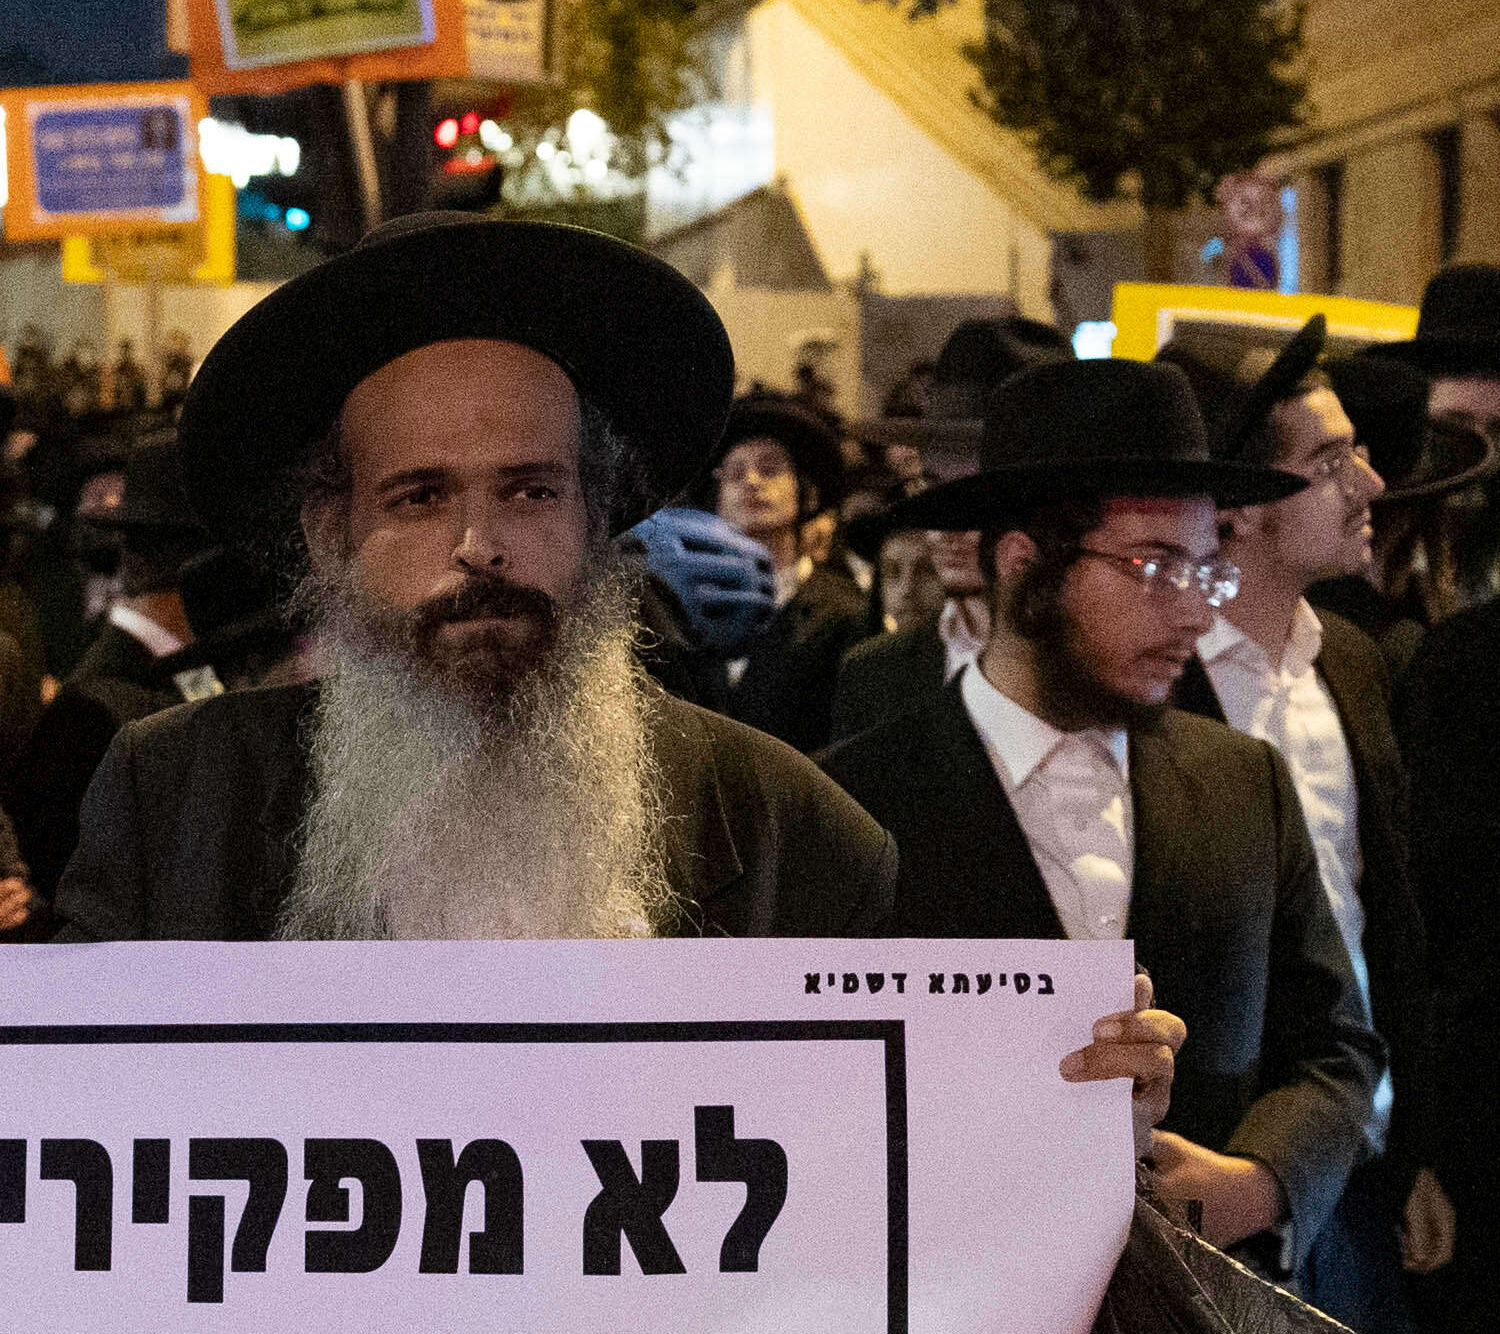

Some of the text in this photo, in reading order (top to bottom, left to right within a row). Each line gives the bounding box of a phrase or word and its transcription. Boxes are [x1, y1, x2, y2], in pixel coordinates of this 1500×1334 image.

[805, 973, 1054, 994] בסיעתא דשמיא
[581, 1106, 788, 1275] לא
